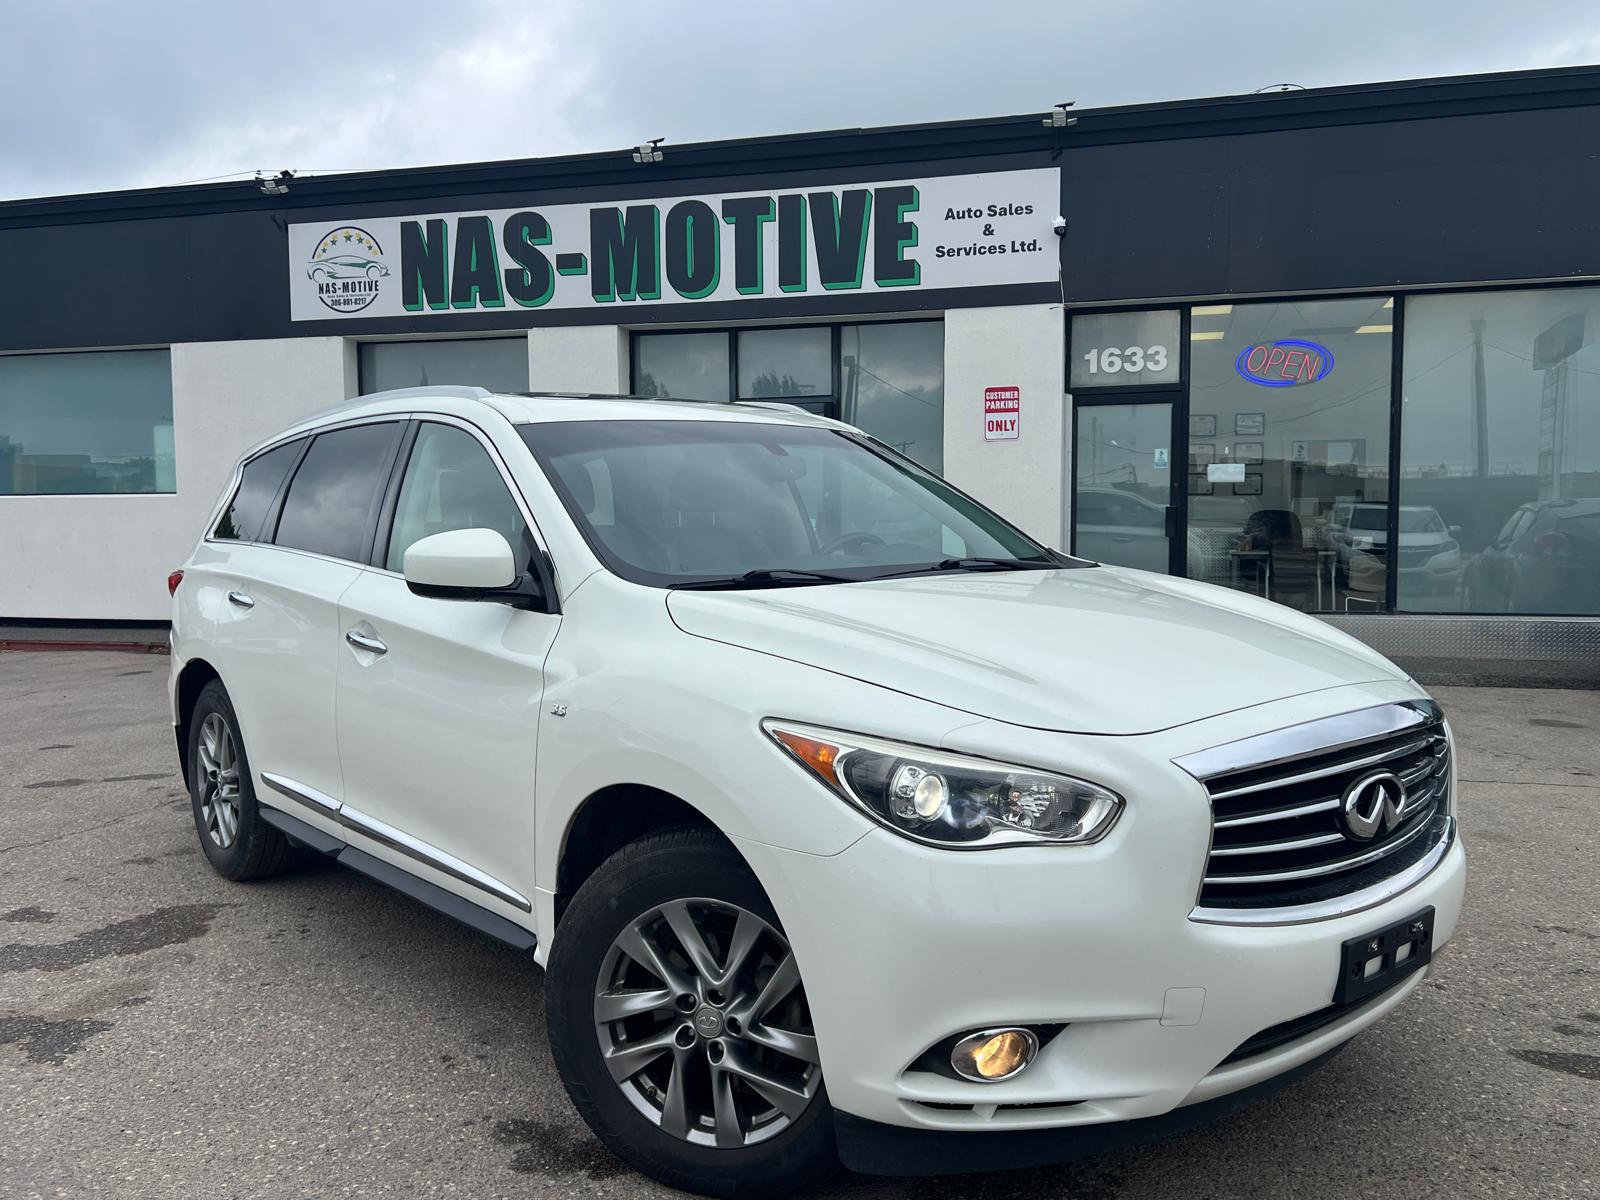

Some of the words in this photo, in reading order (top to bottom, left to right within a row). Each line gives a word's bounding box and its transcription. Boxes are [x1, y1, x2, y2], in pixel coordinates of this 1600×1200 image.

[945, 208, 983, 220] Auto
[987, 203, 1033, 217] Sales
[983, 224, 995, 236] &
[400, 185, 921, 311] NAS-MOTIVE
[936, 243, 1006, 258] Services
[1011, 239, 1042, 253] Ltd.
[319, 280, 379, 294] NAS-MOTIVE
[1084, 345, 1168, 373] 1633
[1248, 345, 1320, 380] OPEN
[986, 391, 1018, 399] CUSTOMER
[986, 400, 1018, 409] PARKING
[987, 420, 1016, 432] ONLY
